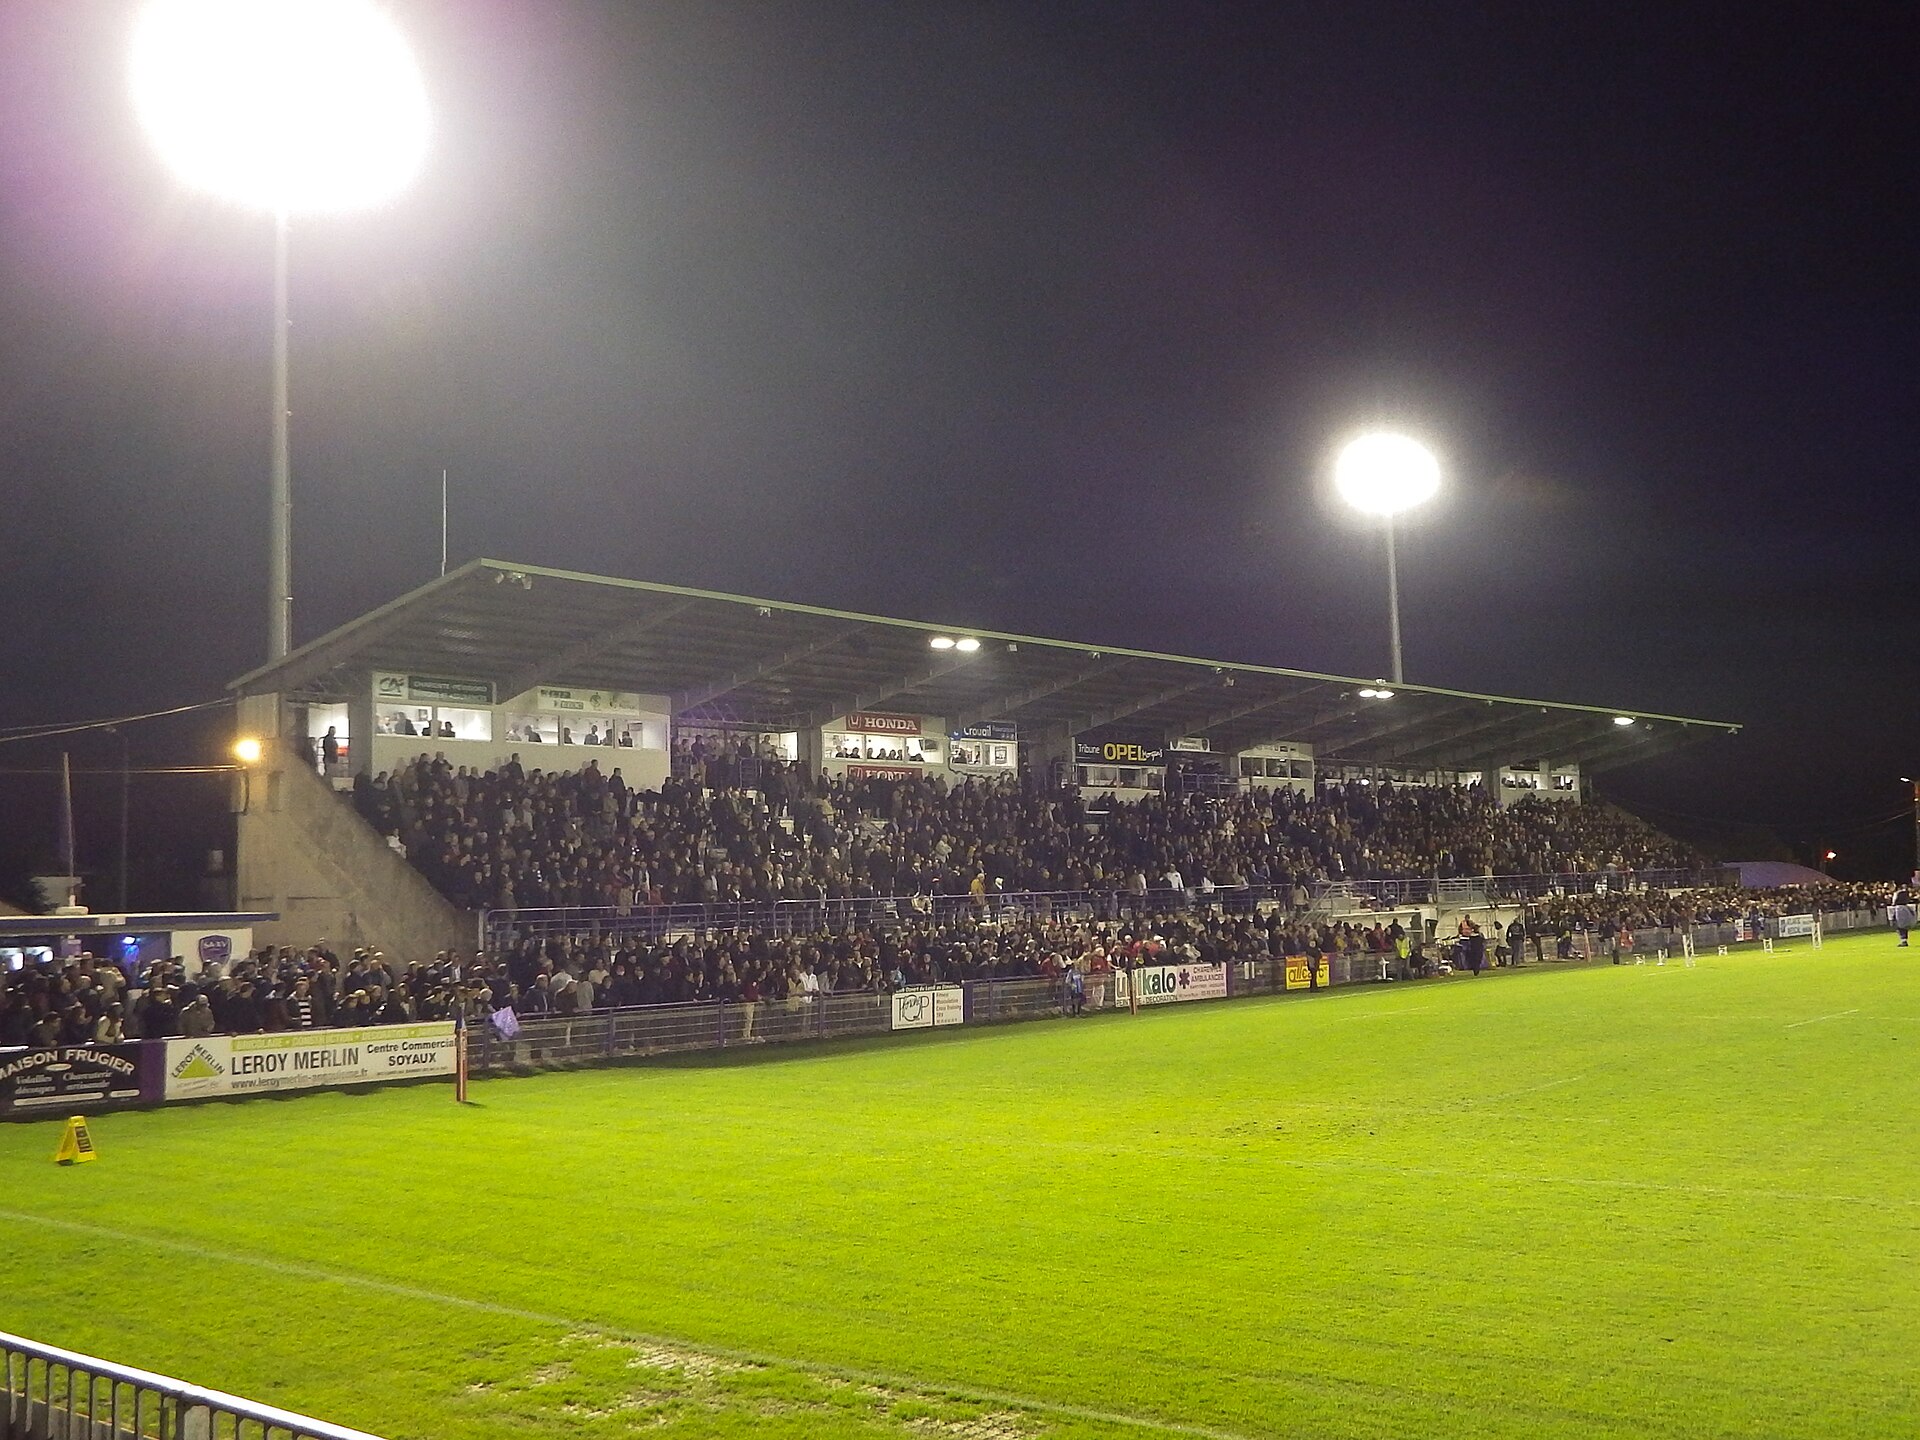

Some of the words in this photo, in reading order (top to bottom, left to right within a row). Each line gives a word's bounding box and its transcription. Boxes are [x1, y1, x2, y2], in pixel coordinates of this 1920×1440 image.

[864, 717, 918, 731] HONDA
[1103, 743, 1147, 762] OPEL
[1116, 967, 1177, 998] uikalo
[367, 1043, 399, 1054] Centre
[388, 1052, 437, 1067] SOYAUX
[65, 1049, 135, 1076] FRUGIER
[171, 1049, 196, 1078] LEROY
[194, 1043, 226, 1075] MERLIN
[230, 1053, 288, 1076] LEROY
[294, 1048, 359, 1070] MERLIN
